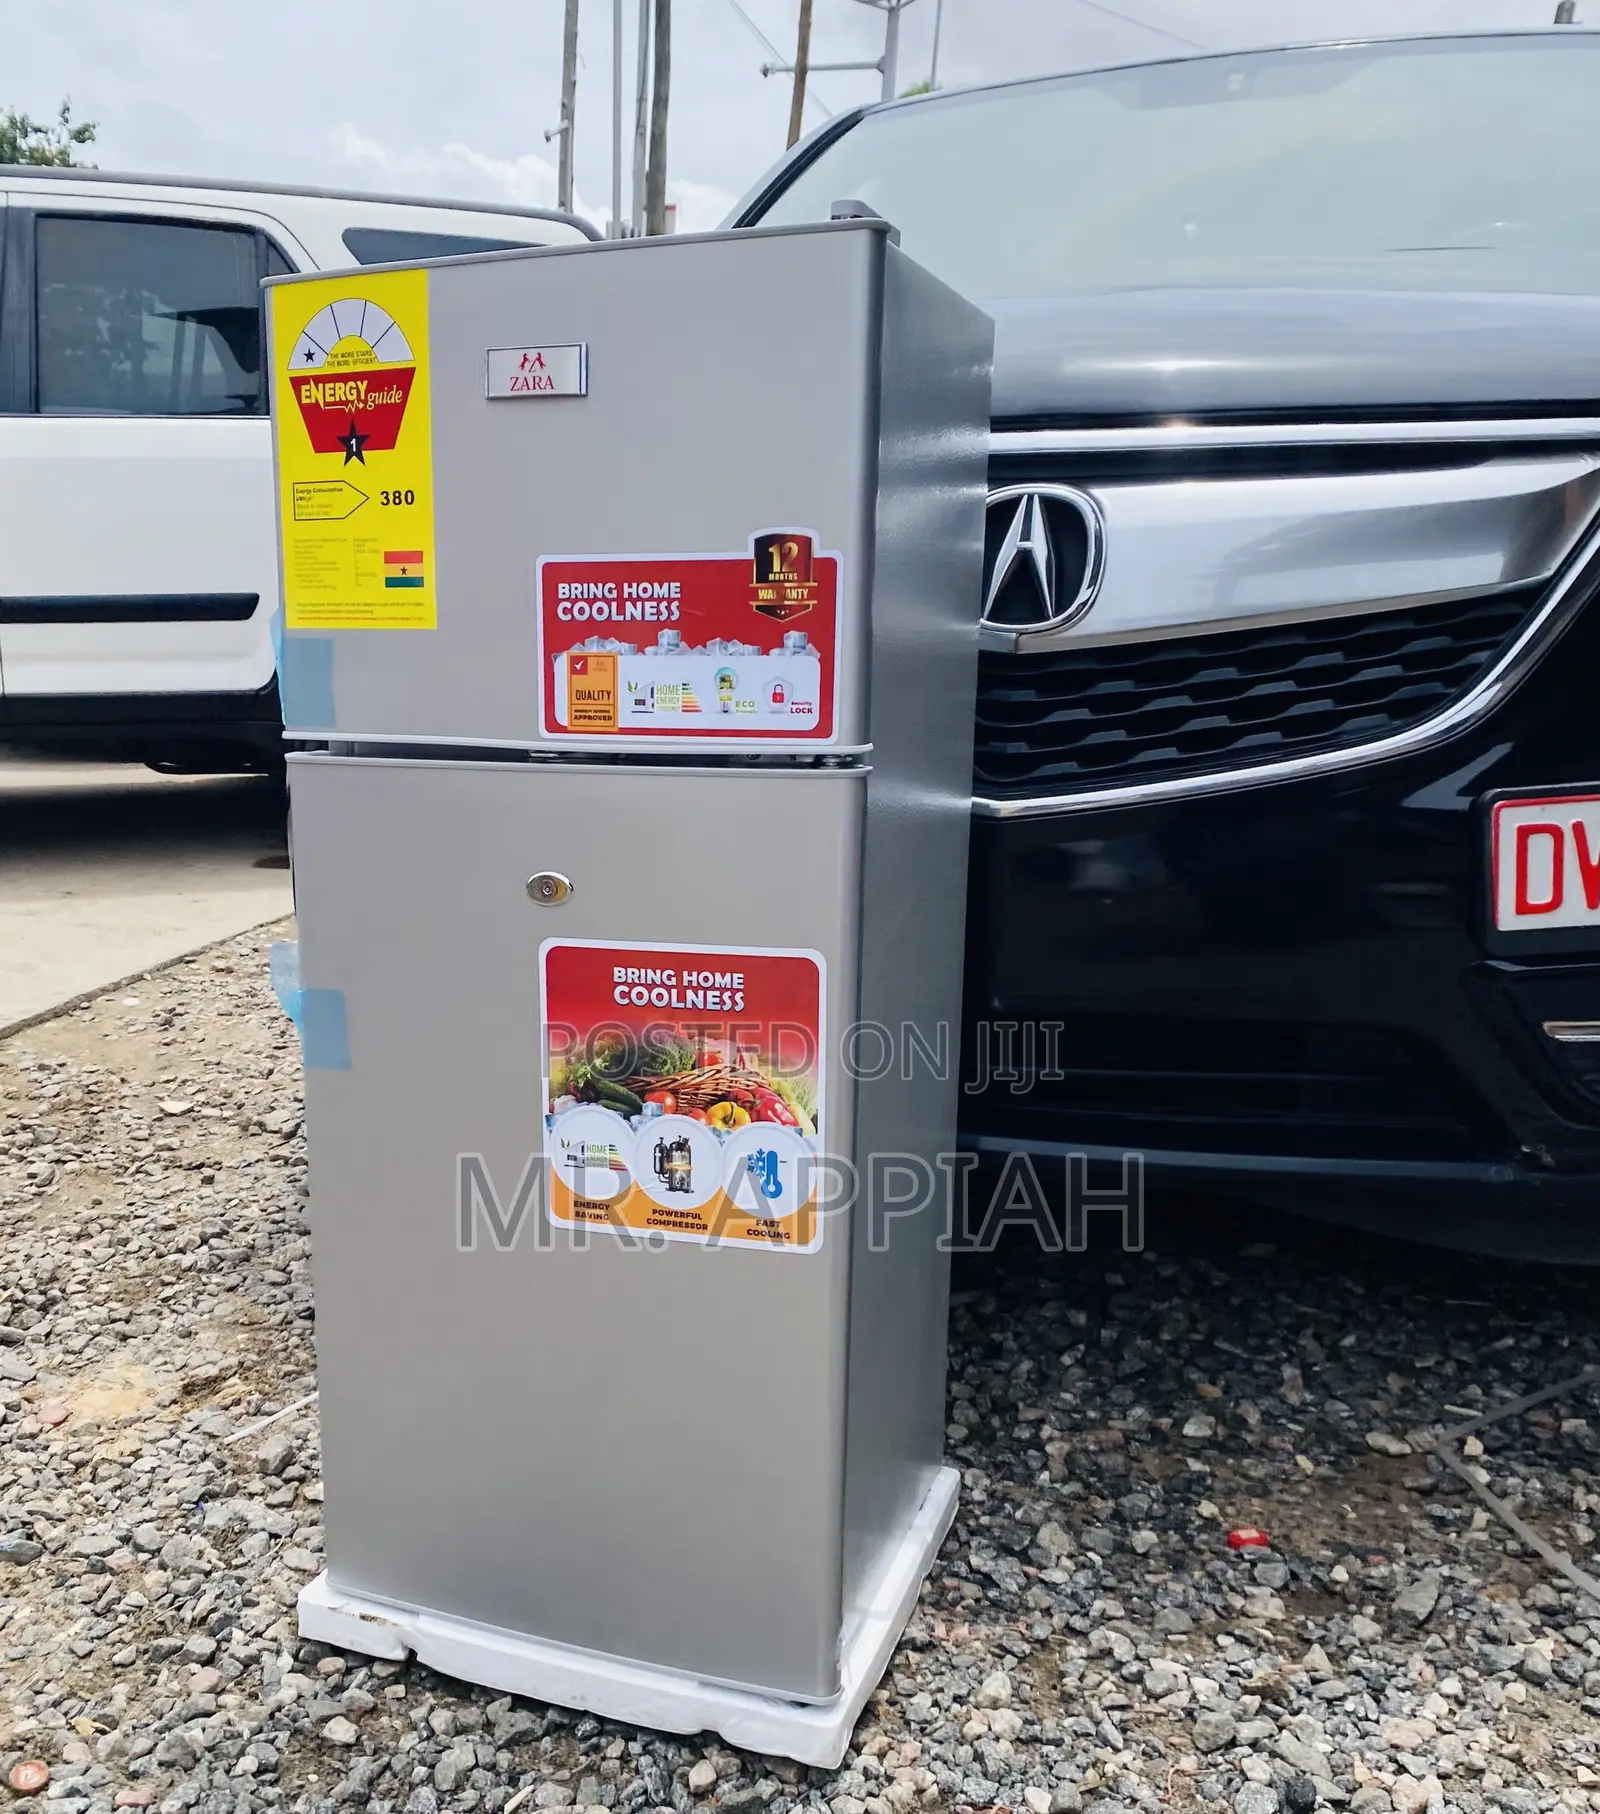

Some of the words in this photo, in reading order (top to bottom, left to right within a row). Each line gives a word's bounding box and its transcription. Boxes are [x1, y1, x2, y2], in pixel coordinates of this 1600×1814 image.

[341, 351, 354, 359] MORE
[336, 359, 350, 367] MORE
[352, 357, 376, 366] EFFICIENT
[509, 374, 555, 392] ZARA
[301, 378, 368, 410] ENERGY
[366, 384, 403, 410] guide
[350, 437, 357, 452] 1
[380, 490, 415, 506] 380
[768, 541, 799, 573] 12
[768, 572, 798, 581] MONTHS
[558, 582, 618, 599] BRING
[623, 582, 681, 599] HOME
[758, 587, 809, 600] WAANTY
[557, 601, 680, 621] COOLNESS
[575, 689, 612, 701] QUALITY
[656, 684, 681, 696] HOME
[613, 966, 677, 986] BRING
[682, 970, 745, 989] HOME
[613, 985, 745, 1012] COOLNESS
[586, 1143, 608, 1154] HOME
[573, 1200, 610, 1211] ENERGY
[651, 1208, 703, 1221] POWERFUL
[646, 1218, 708, 1231] COMPRESSOR
[756, 1219, 781, 1229] FAST
[746, 1228, 791, 1240] COOLING
